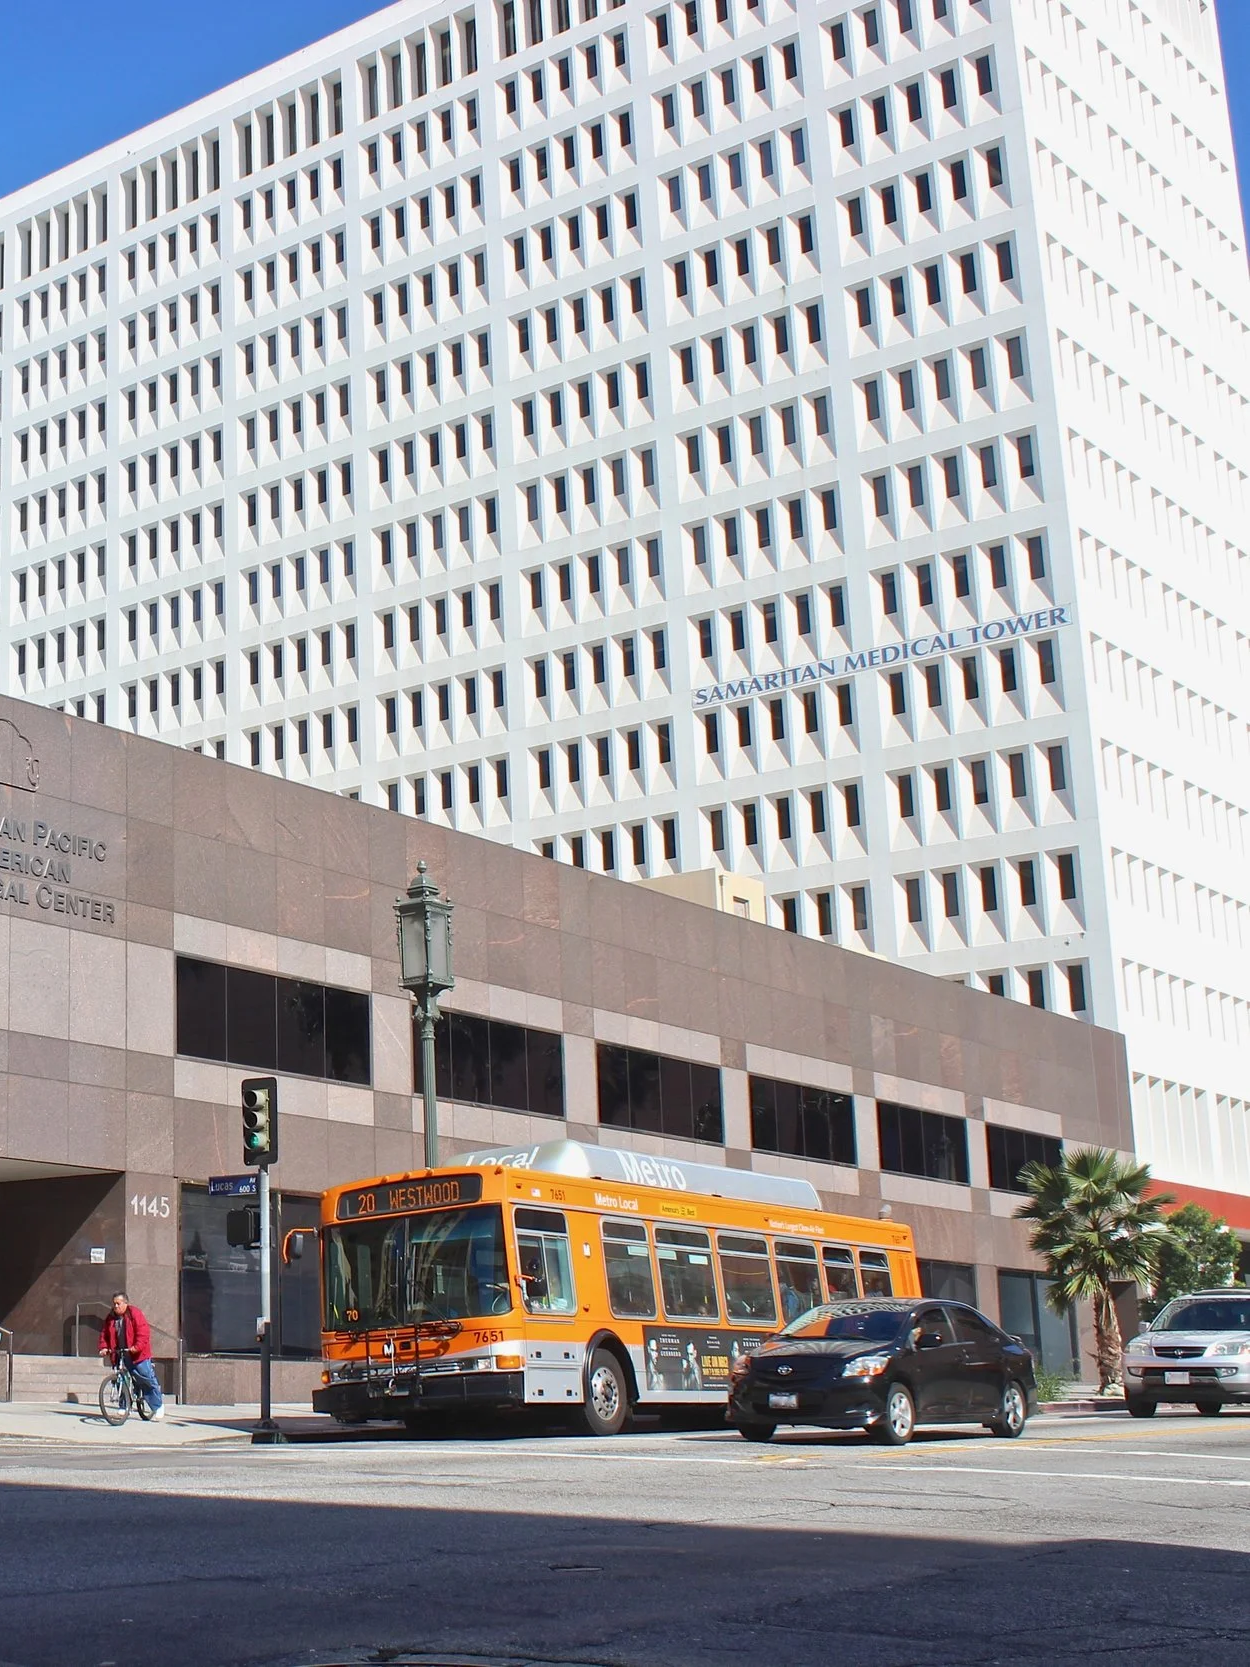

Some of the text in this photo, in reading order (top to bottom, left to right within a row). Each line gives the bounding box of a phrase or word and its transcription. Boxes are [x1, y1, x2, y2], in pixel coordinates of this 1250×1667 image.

[695, 607, 1068, 706] SAMARITAN MEDICAL TOWER
[33, 820, 106, 862] PACIFIC
[35, 883, 115, 924] CENTER
[614, 1150, 686, 1190] Metro
[211, 1180, 234, 1191] Lucas
[239, 1185, 250, 1193] 600
[550, 1188, 566, 1200] 7651
[131, 1194, 170, 1218] 1145
[358, 1181, 460, 1215] 20 WESTWOOD
[594, 1192, 639, 1210] Metro Local
[346, 1309, 359, 1322] 70
[473, 1330, 504, 1345] 7651
